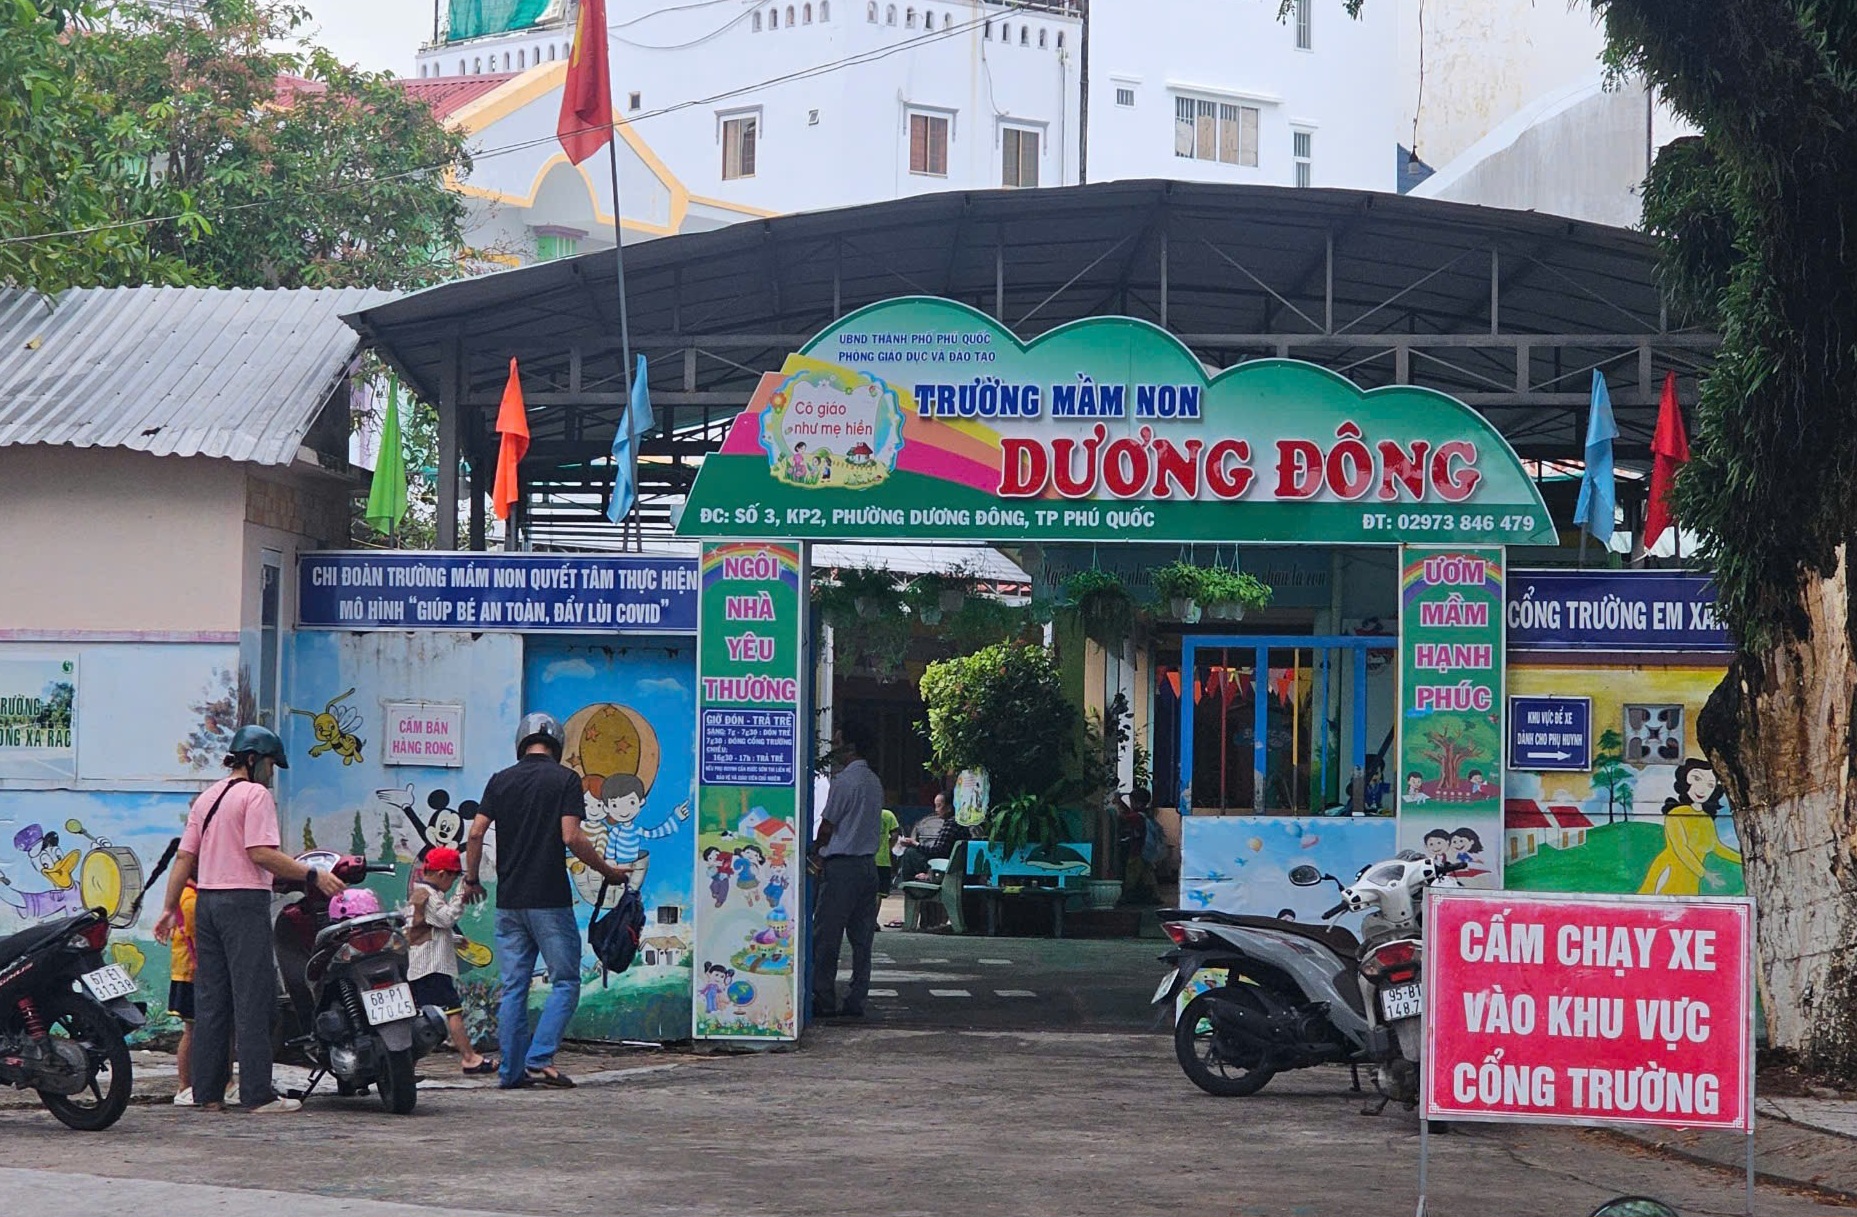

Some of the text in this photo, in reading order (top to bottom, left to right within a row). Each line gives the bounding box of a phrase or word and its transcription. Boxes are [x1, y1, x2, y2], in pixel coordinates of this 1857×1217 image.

[839, 330, 991, 345] UBND THÀNH PHỐ PHÚ QUỐC
[839, 349, 996, 363] PHÒNG GIÁO DỤC VÀ ĐÀO TẠO
[914, 371, 1201, 418] TRƯỜNG MẦM NON
[795, 400, 847, 420] Cô giáo
[794, 419, 874, 440] như mẹ hiền
[997, 420, 1482, 501] DƯƠNG ĐÔNG
[700, 503, 1155, 529] ĐC: SỐ 3, KP2, PHƯỜNG DƯƠNG ĐÔNG, TP PHÚ QUỐC
[1362, 514, 1535, 532] ĐT: 02973 846 479
[312, 561, 697, 594] CHI ĐOÀN TRƯỜNG MẦM NON QUYẾT TÂM THỰC HIỆN
[724, 551, 779, 579] NGÔI
[1424, 555, 1485, 585] ƯƠM
[339, 597, 364, 620] MÔ
[368, 597, 404, 620] HÌNH
[456, 597, 475, 621] BÉ
[480, 602, 502, 622] AN
[506, 598, 550, 624] TOÀN,
[554, 595, 584, 623] ĐẨY
[588, 598, 612, 624] LÙI
[726, 591, 775, 619] NHÀ
[1420, 593, 1488, 627] MẦM
[1508, 586, 1561, 630] CỔNG
[1567, 593, 1647, 631] TRƯỜNG
[1652, 602, 1683, 630] EM
[727, 632, 774, 660] YÊU
[1415, 645, 1492, 673] HẠNH
[703, 674, 797, 702] THƯƠNG
[1416, 678, 1492, 711] PHÚC
[399, 717, 449, 735] CẤM BÁN
[706, 714, 722, 725] GIỜ
[725, 713, 744, 725] ĐÓN
[752, 713, 771, 725] TRẢ
[773, 714, 792, 726] TRẺ
[1527, 706, 1573, 727] KHU VỰC ĐỂ XE
[392, 736, 454, 756] HÀNG RONG
[1517, 730, 1583, 749] DÀNH CHO PHỤ HUYNH
[1459, 908, 1716, 977] CẤM CHẠY XE
[1388, 984, 1422, 1002] 95-B1
[1463, 985, 1710, 1050] VÀO KHU VỰC
[1453, 1048, 1719, 1115] CỔNG TRƯỜNG
